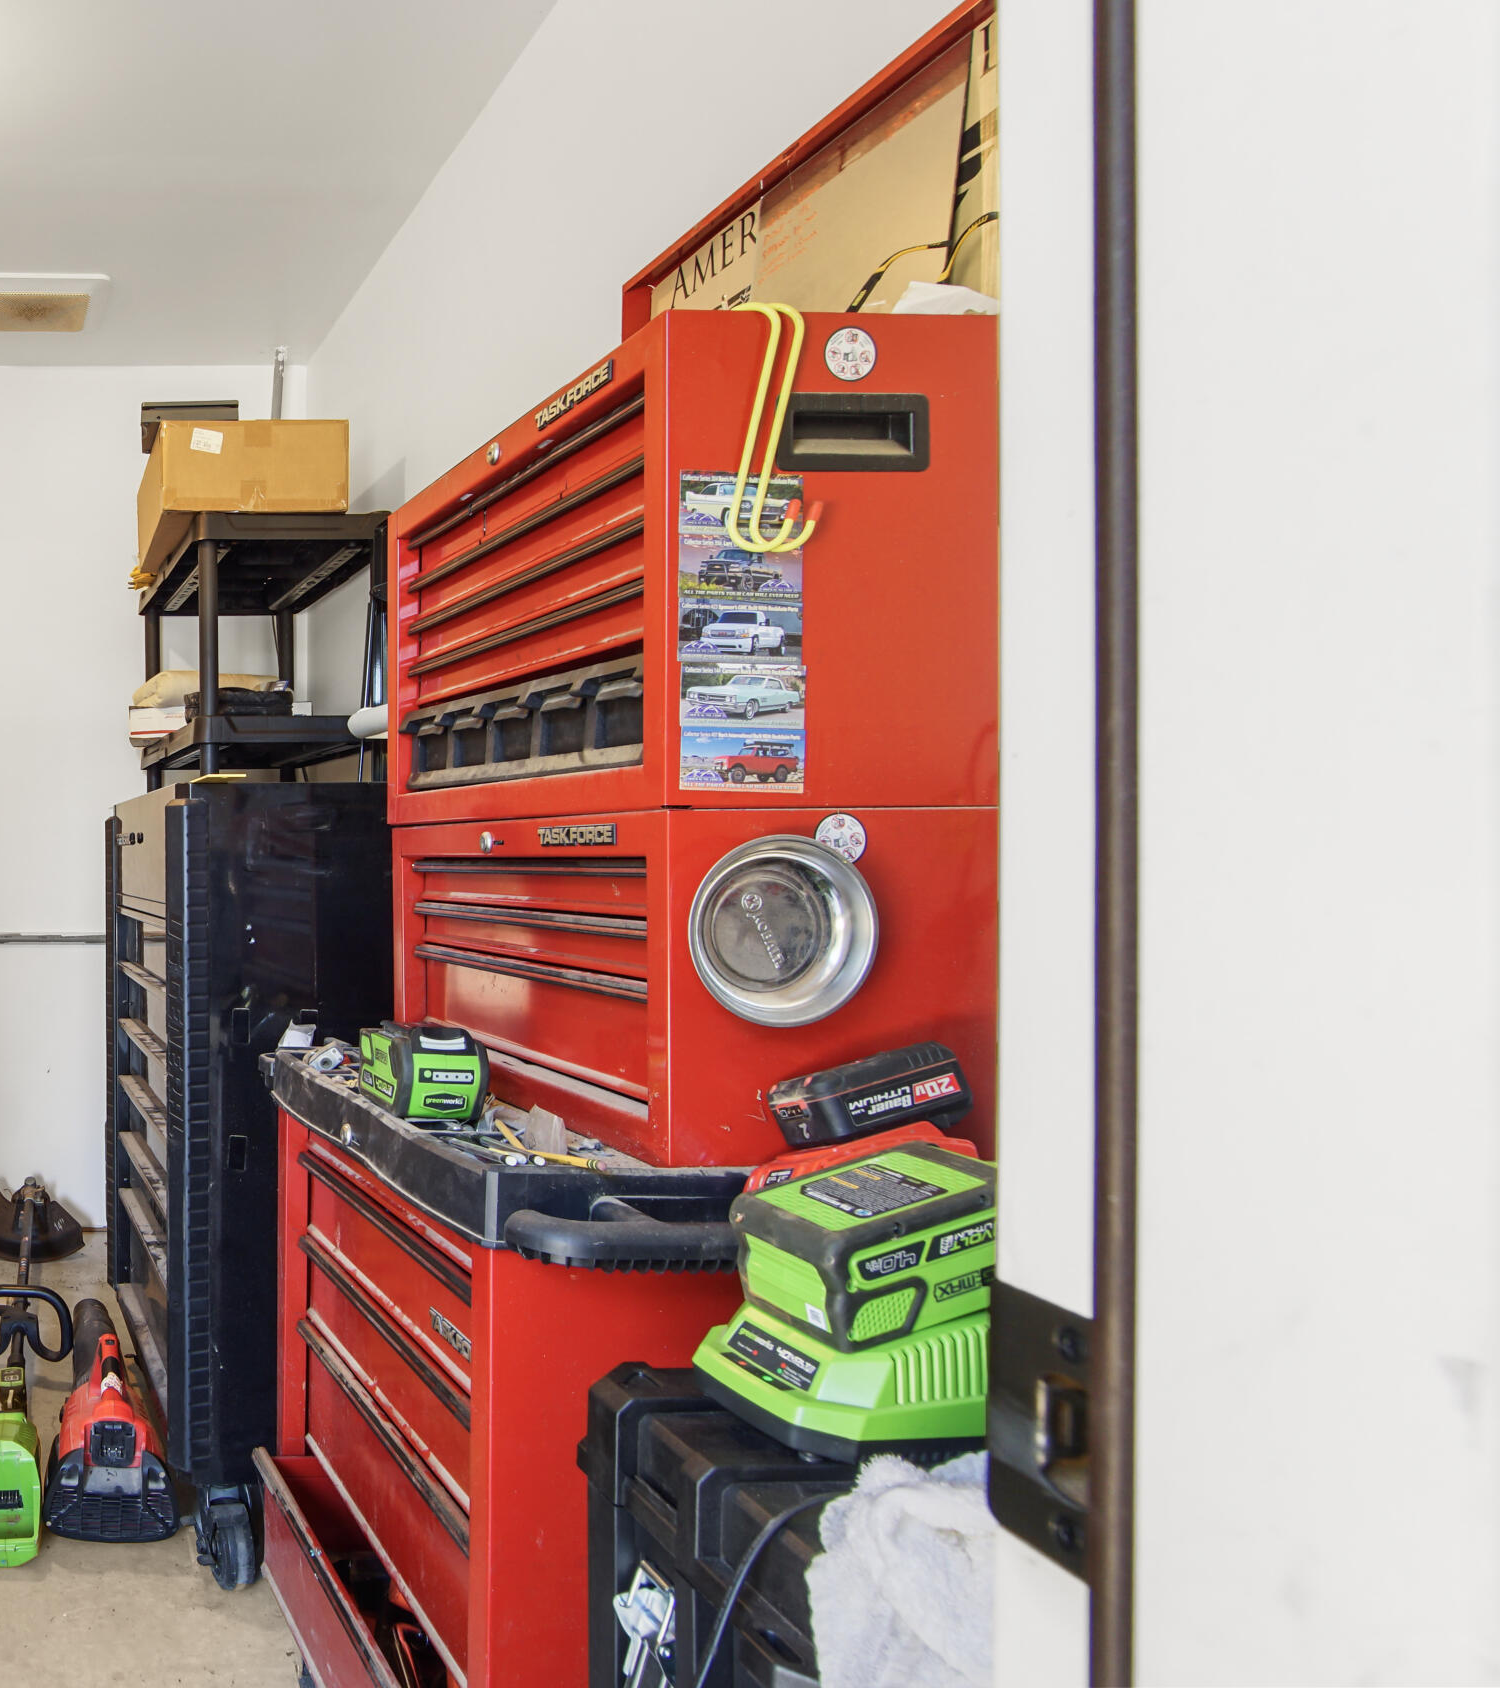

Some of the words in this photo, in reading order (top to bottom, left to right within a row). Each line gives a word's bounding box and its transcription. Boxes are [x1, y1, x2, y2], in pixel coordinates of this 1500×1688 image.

[848, 1085, 912, 1112] LITHIUM
[867, 1094, 913, 1115] Bauer
[430, 1307, 472, 1363] TASKFO
